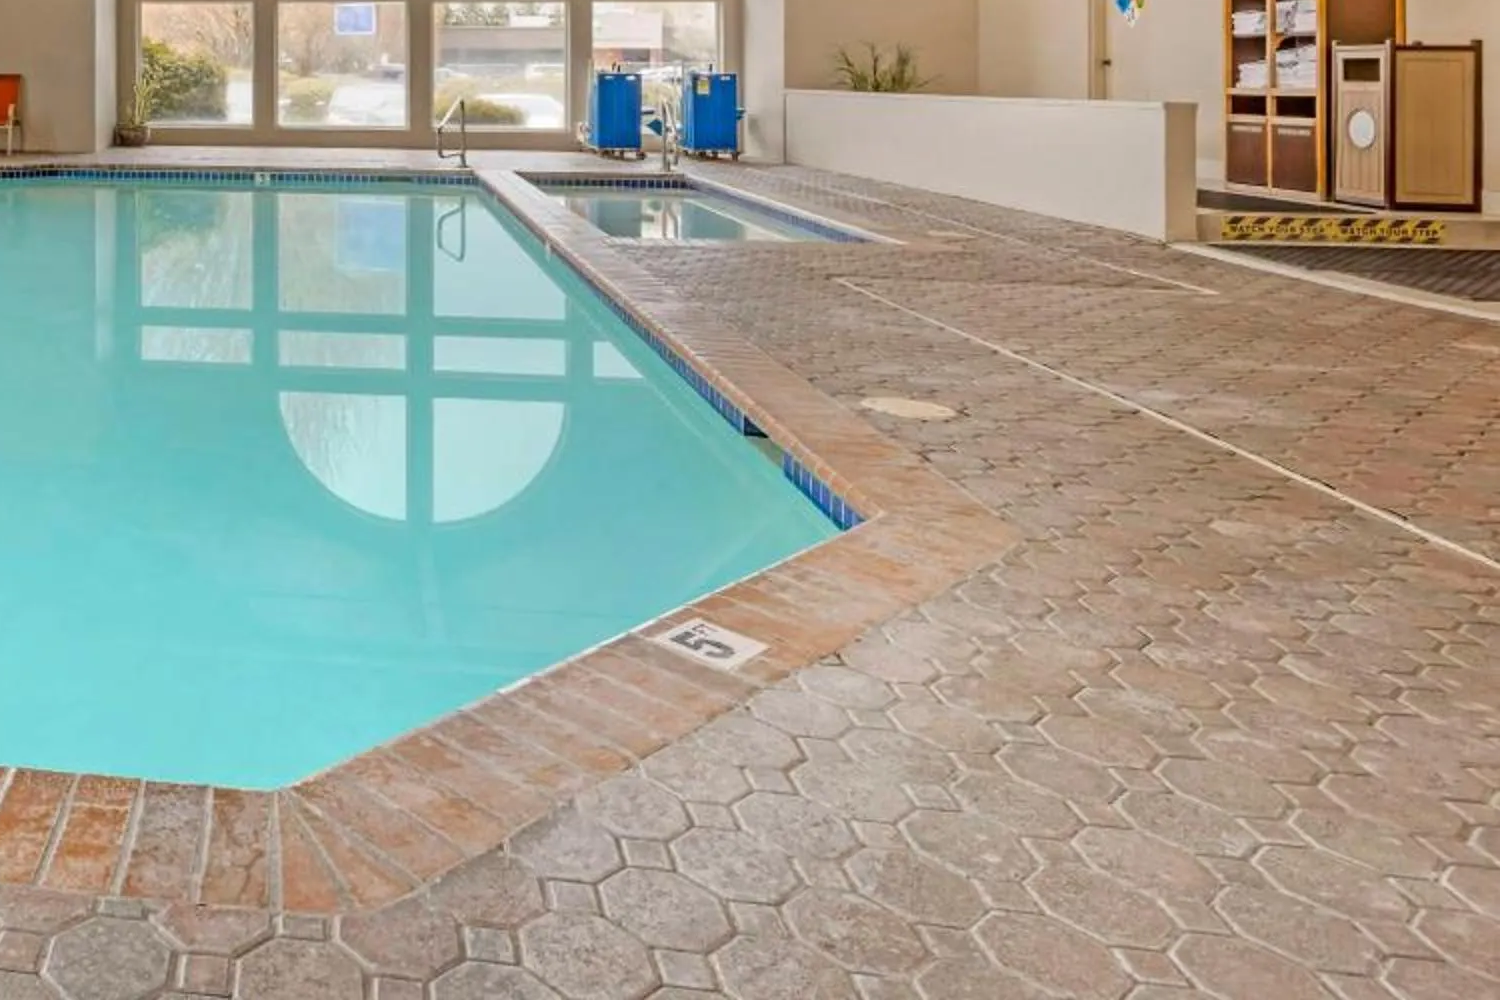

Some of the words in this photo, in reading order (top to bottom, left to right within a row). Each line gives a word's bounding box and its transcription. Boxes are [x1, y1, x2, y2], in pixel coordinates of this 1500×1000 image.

[1230, 224, 1265, 233] WATCH
[1268, 224, 1297, 233] YOUR
[1300, 225, 1325, 235] STEP
[1341, 226, 1377, 236] WATCH
[1380, 227, 1409, 237] YOUR
[1412, 227, 1439, 237] STEP
[670, 630, 735, 659] 5
